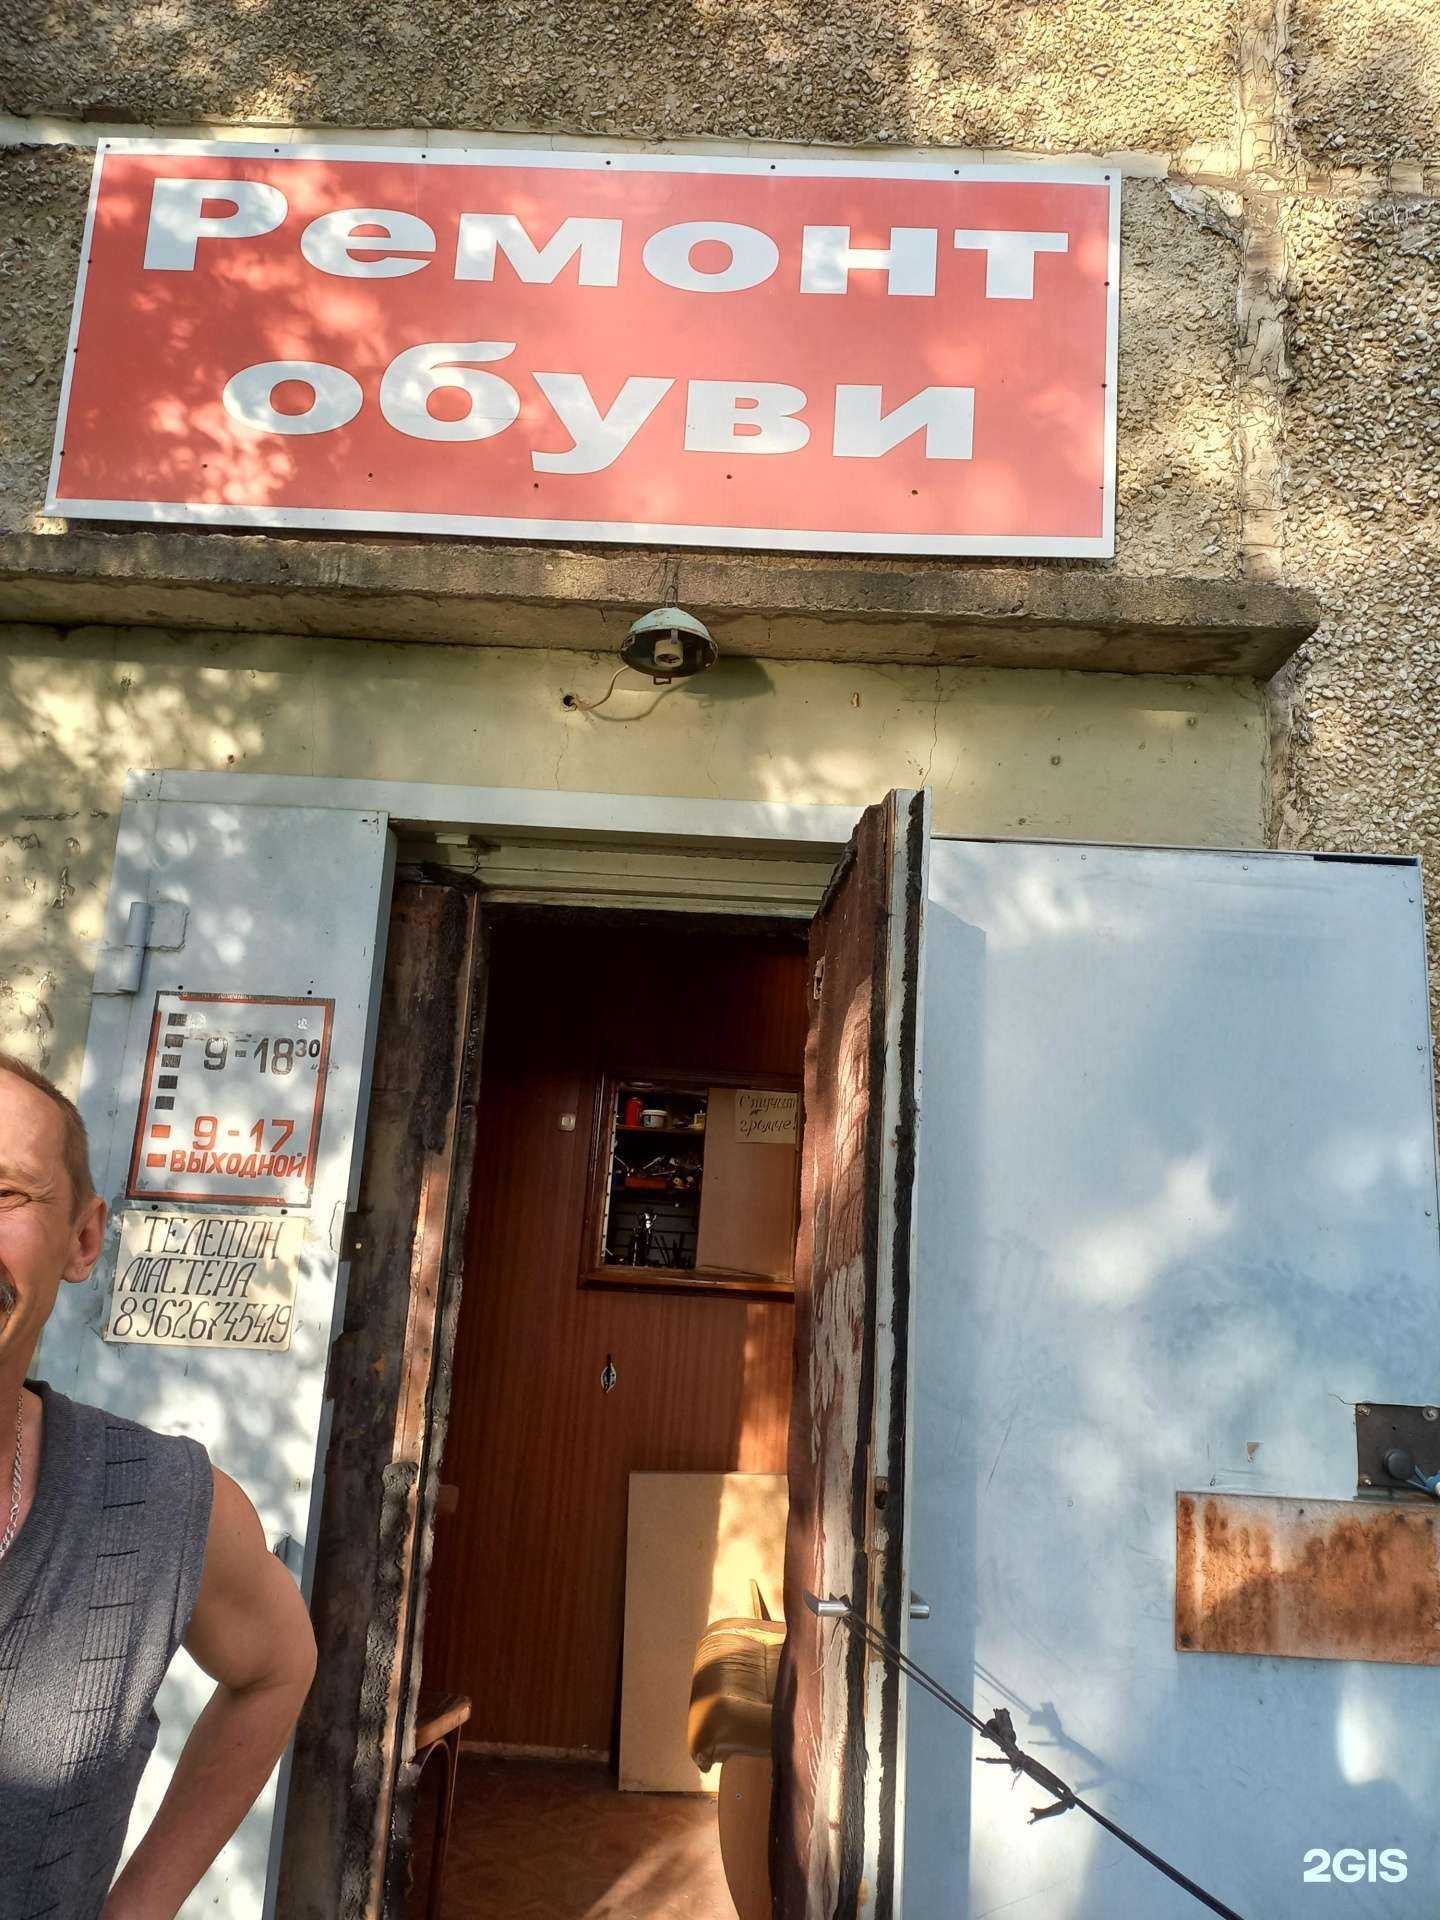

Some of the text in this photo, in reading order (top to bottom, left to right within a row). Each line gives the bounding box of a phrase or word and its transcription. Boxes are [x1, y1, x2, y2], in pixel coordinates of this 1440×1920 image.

[142, 177, 1069, 300] Ремонт
[222, 341, 976, 475] обуви
[169, 1149, 307, 1179] ВЫХОДНОЙ
[144, 1215, 285, 1260] ТЕЛЕФОН
[117, 1256, 257, 1298] МАСТЕРА
